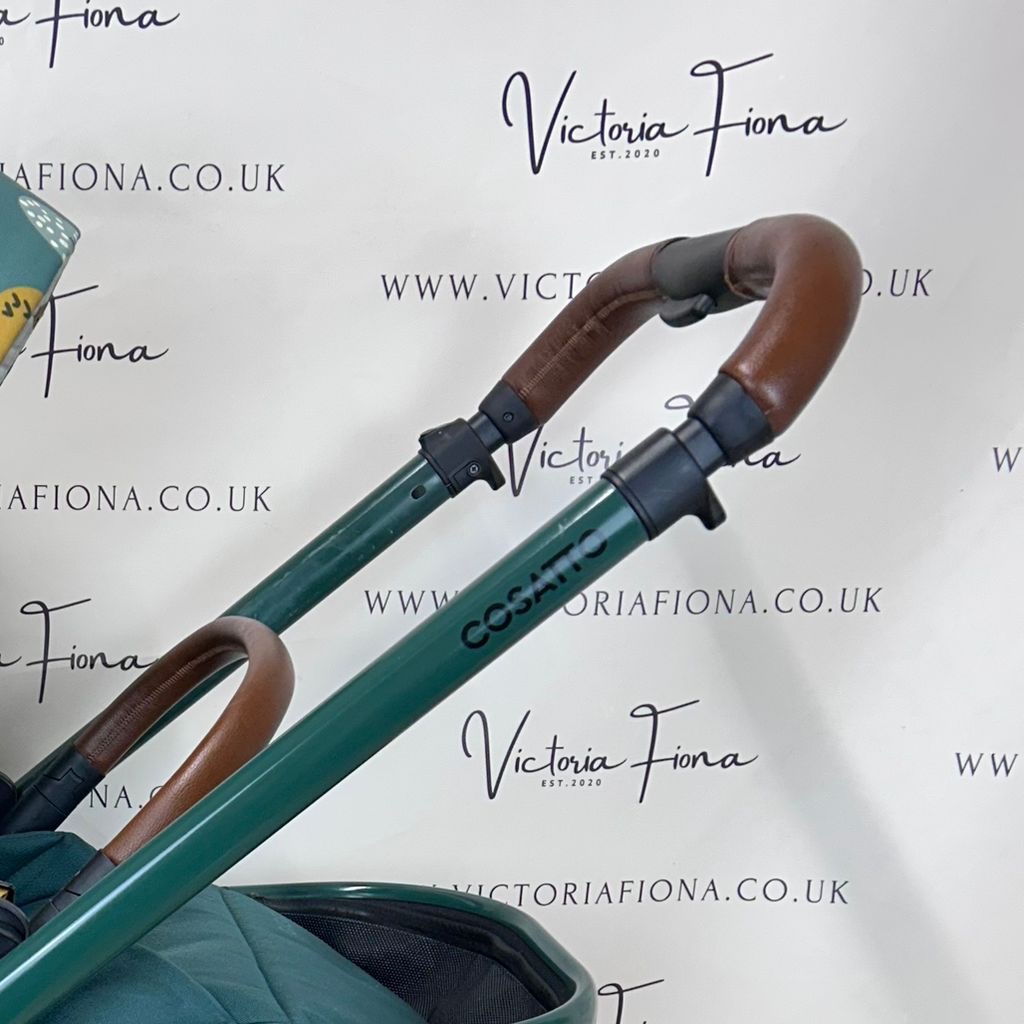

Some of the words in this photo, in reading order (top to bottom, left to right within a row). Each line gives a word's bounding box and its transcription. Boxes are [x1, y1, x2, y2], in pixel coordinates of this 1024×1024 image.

[501, 70, 688, 176] Victoria
[690, 53, 847, 177] Fiona
[590, 149, 661, 161] EST.2020
[31, 284, 170, 399] Fiona
[460, 527, 609, 650] COSATTO
[20, 598, 158, 704] Fiona
[461, 709, 627, 800] Victoria
[629, 700, 759, 803] Fiona
[541, 779, 603, 788] EST.2020
